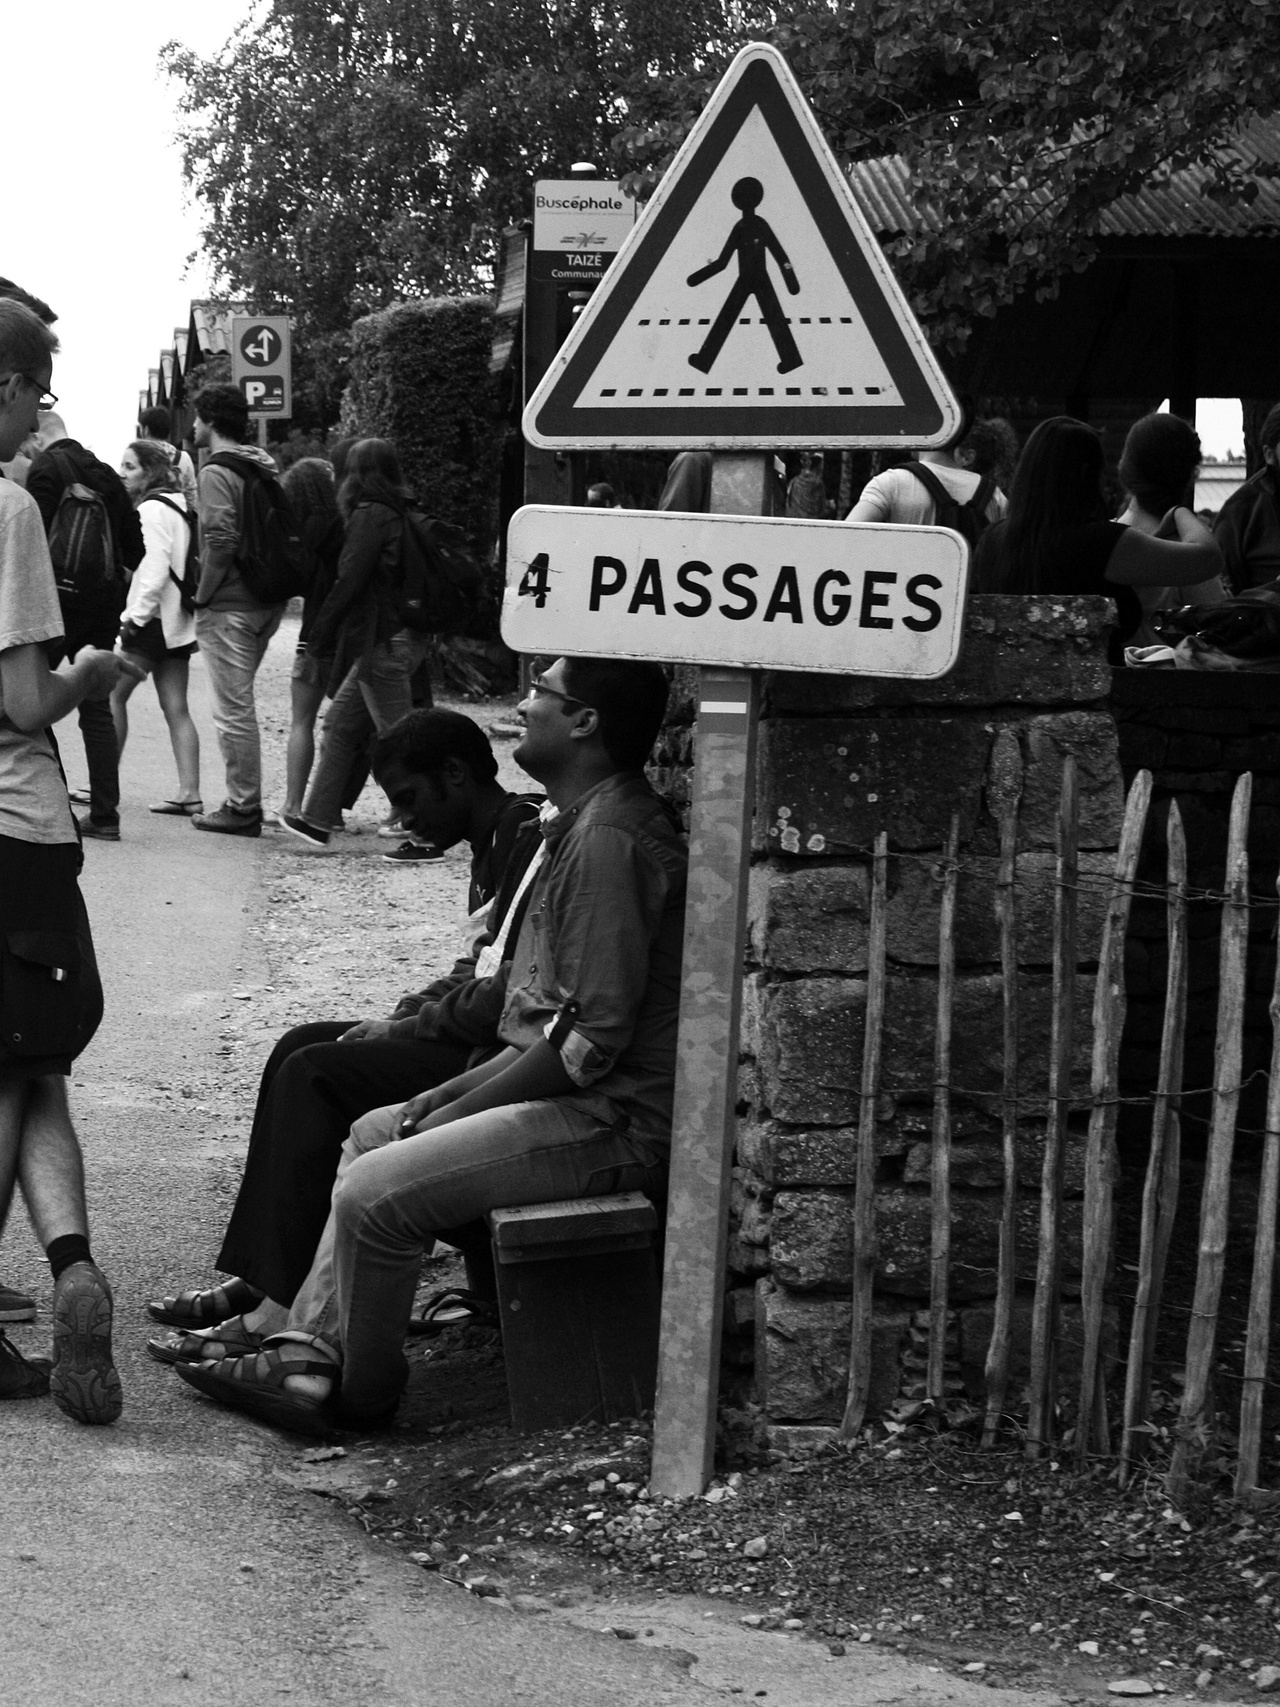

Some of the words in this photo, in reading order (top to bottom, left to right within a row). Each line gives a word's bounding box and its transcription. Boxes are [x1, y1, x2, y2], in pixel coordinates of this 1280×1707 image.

[536, 195, 623, 211] Buscéphale
[566, 251, 602, 267] TAIZÉ
[246, 381, 266, 405] P
[518, 552, 552, 609] 4
[588, 555, 944, 633] PASSAGES
